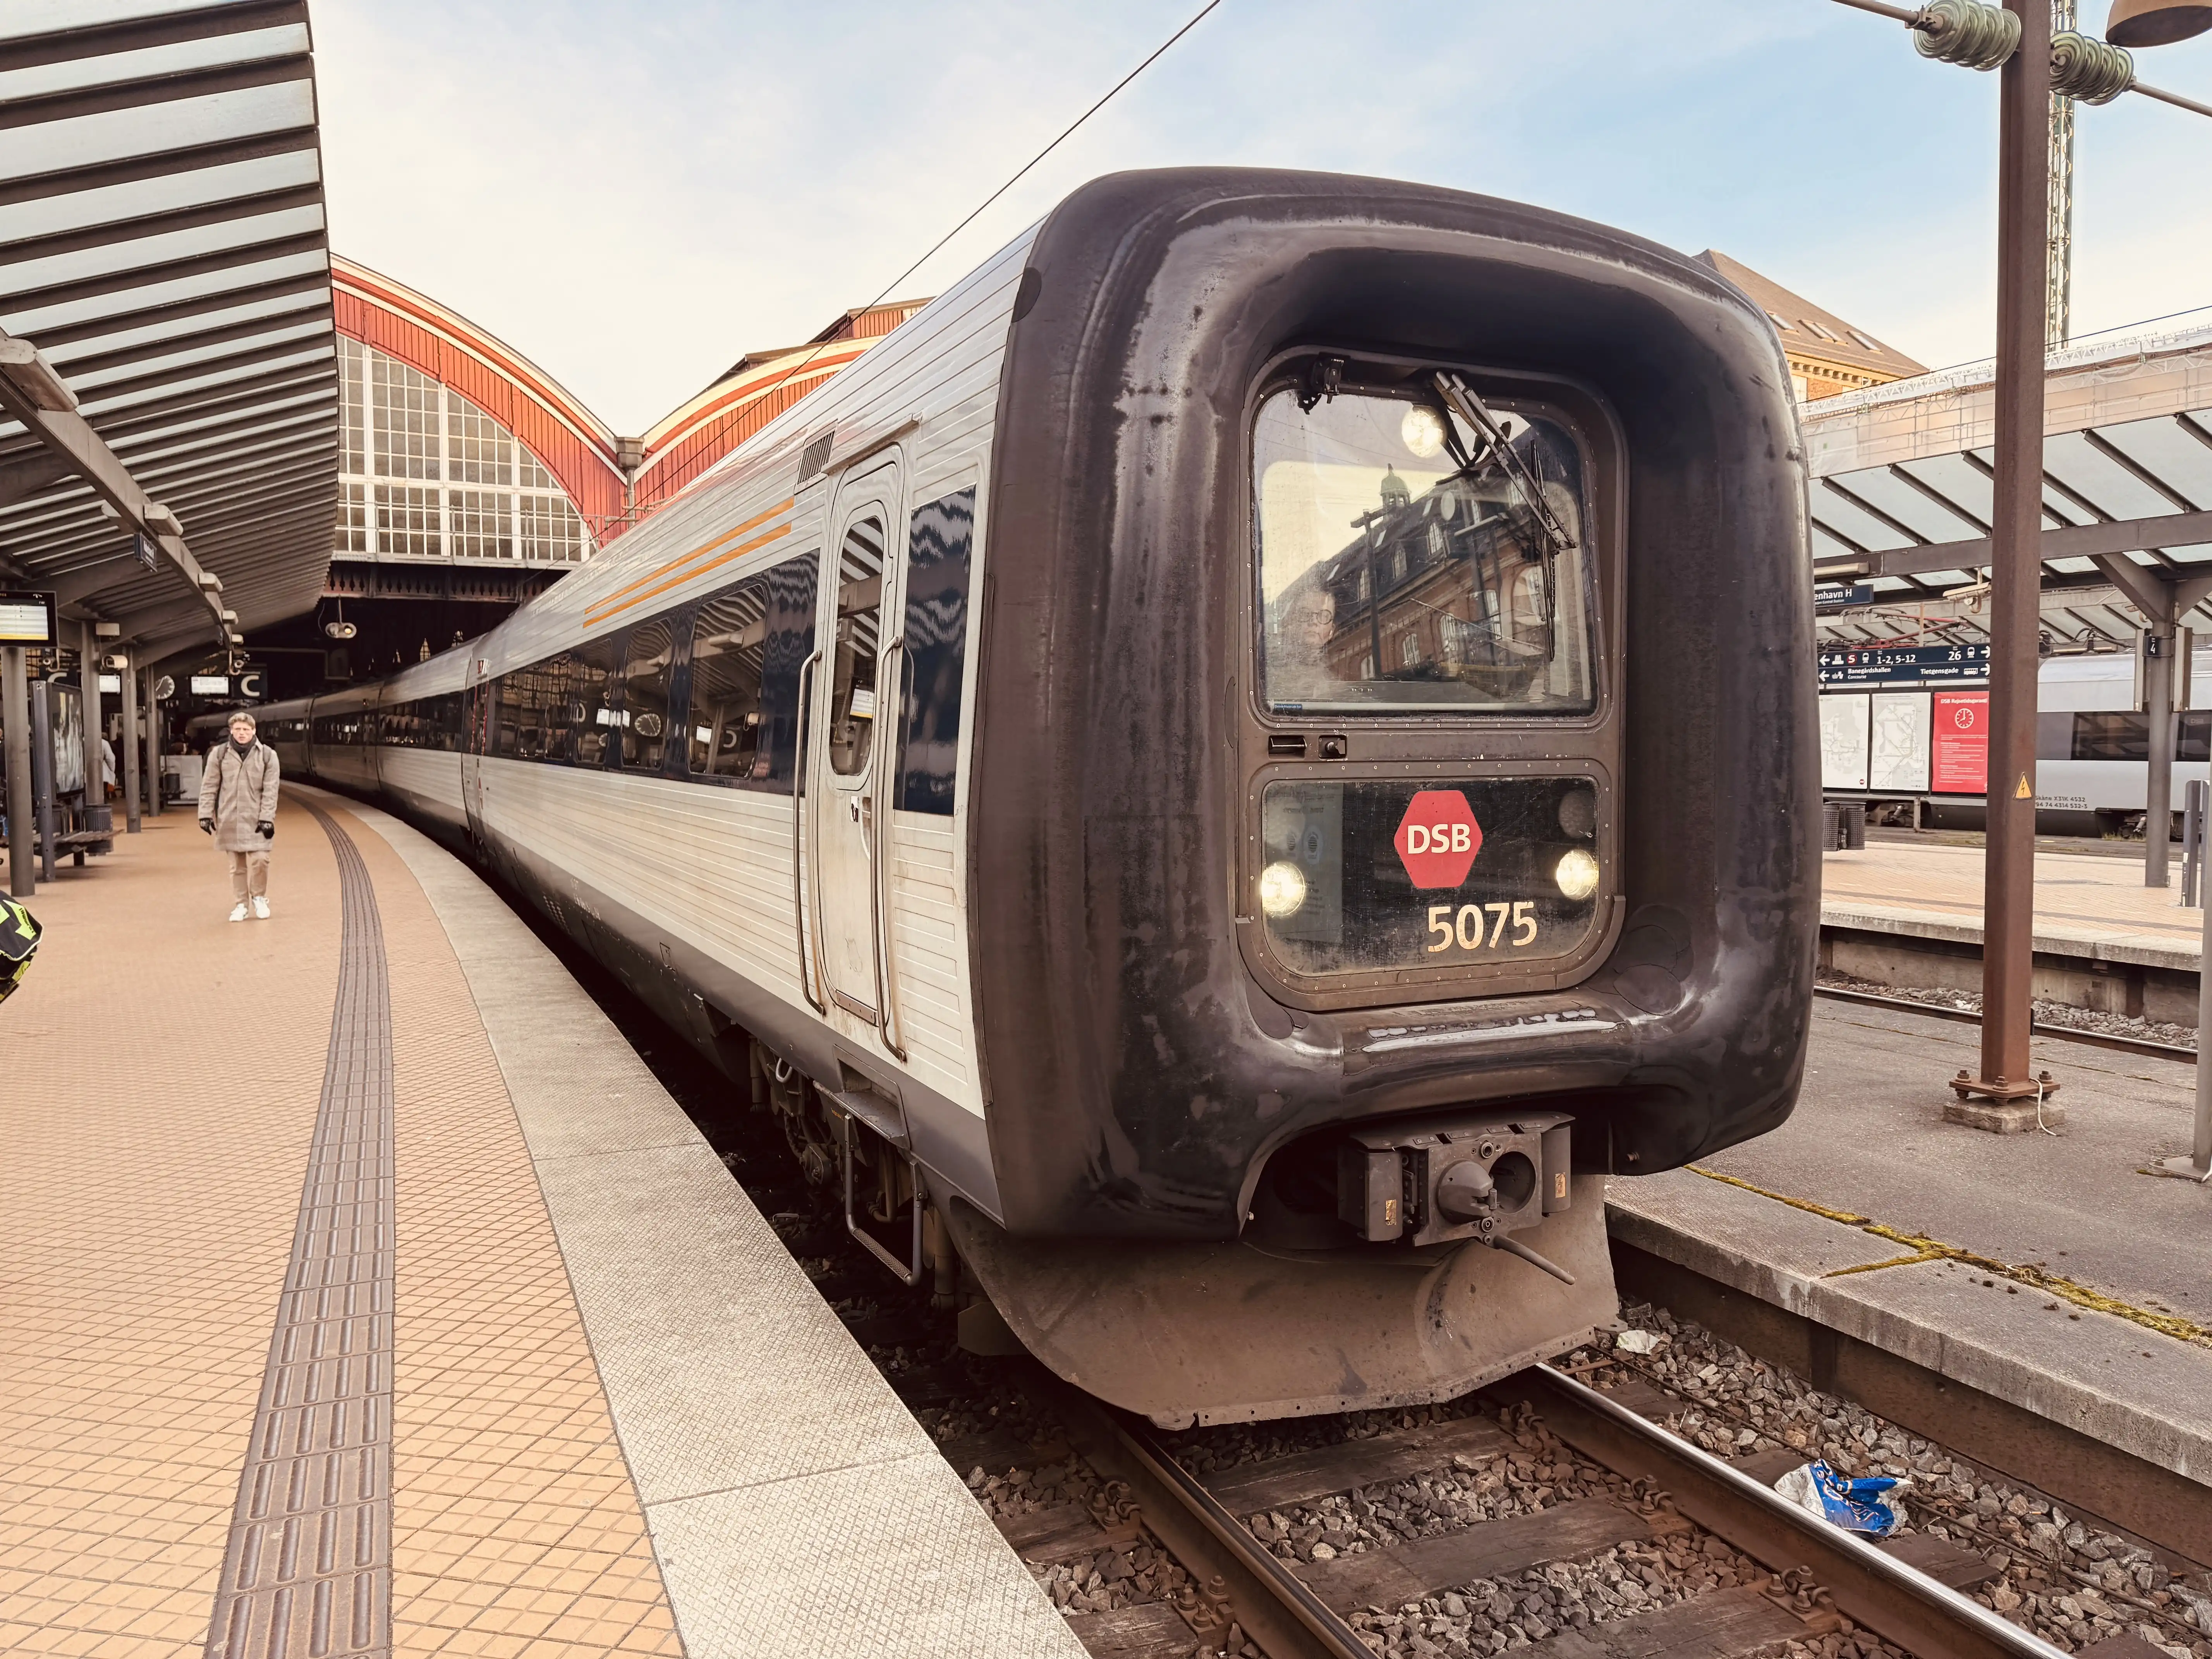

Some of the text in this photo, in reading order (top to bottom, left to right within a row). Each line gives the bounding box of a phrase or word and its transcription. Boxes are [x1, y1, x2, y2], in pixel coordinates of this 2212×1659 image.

[1814, 588, 1852, 601] enhavn H
[2150, 644, 2155, 654] 4
[1848, 654, 1916, 665] S 1-2, 5-12
[1948, 651, 1961, 661] 26
[241, 675, 260, 697] C
[1407, 823, 1471, 854] DSB
[1427, 901, 1538, 953] 5075
